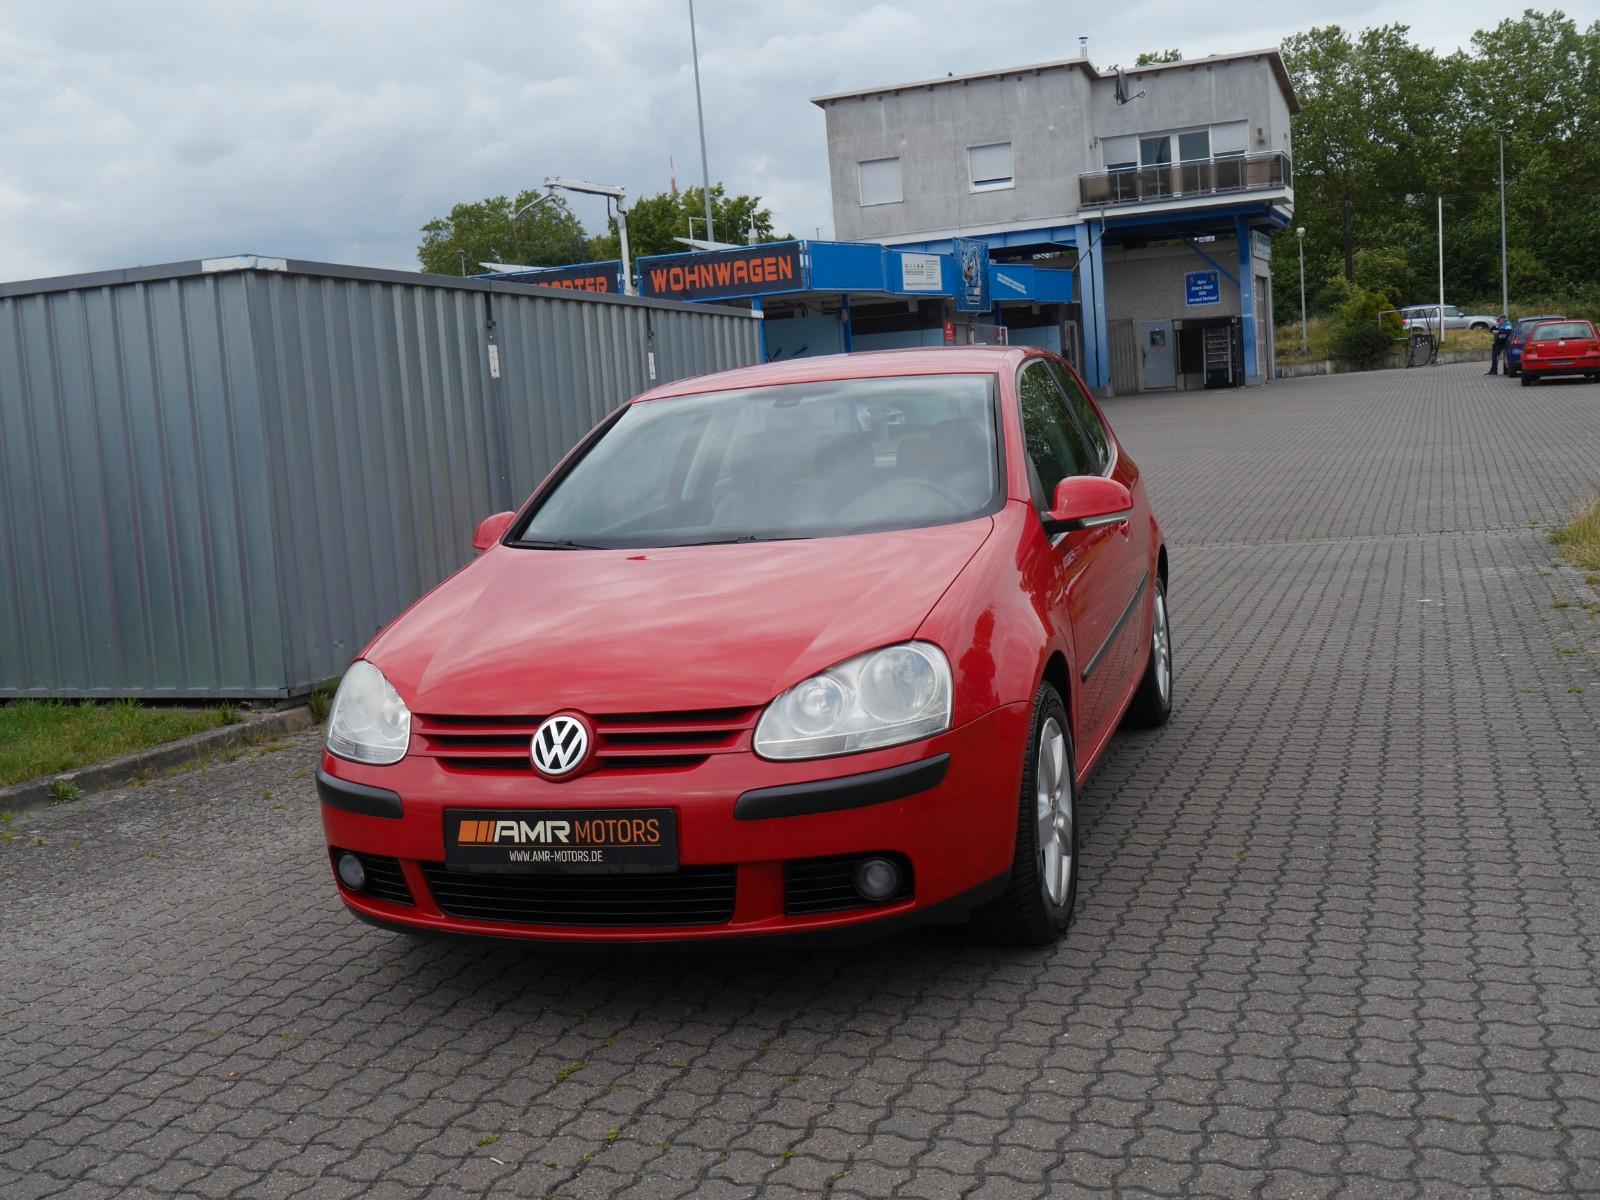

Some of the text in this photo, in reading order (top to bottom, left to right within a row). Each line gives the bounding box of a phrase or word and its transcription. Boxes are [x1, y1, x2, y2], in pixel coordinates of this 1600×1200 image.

[650, 255, 793, 293] WOHNWAGEN
[531, 715, 588, 774] VW
[494, 818, 661, 843] AMR MOTORS
[509, 850, 604, 863] WWW.AMR-MOTORS.DE
